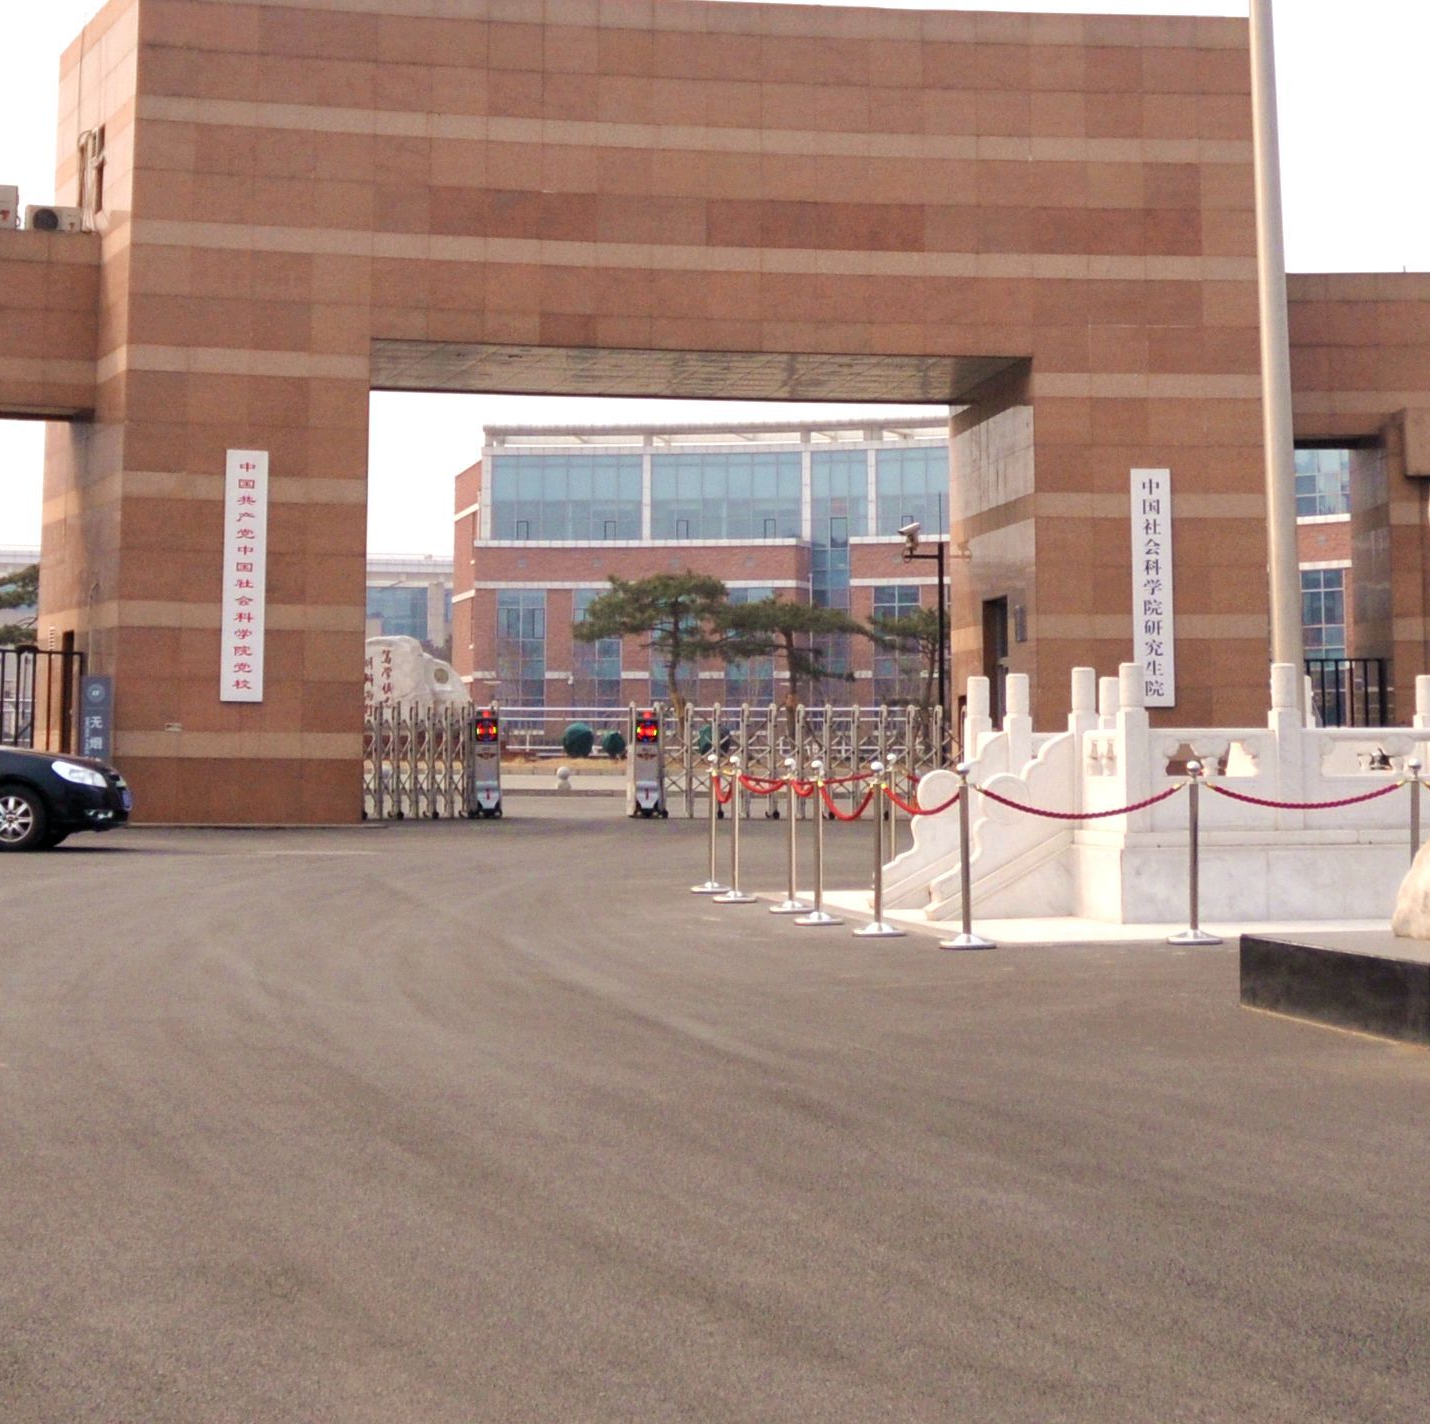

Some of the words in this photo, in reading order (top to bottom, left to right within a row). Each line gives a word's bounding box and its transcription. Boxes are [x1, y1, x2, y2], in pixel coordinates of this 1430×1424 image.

[232, 461, 256, 690] 中国共产党中国社会科学院党校
[1142, 478, 1164, 697] 中国社会科学院研究生院
[90, 715, 103, 761] 无烟
